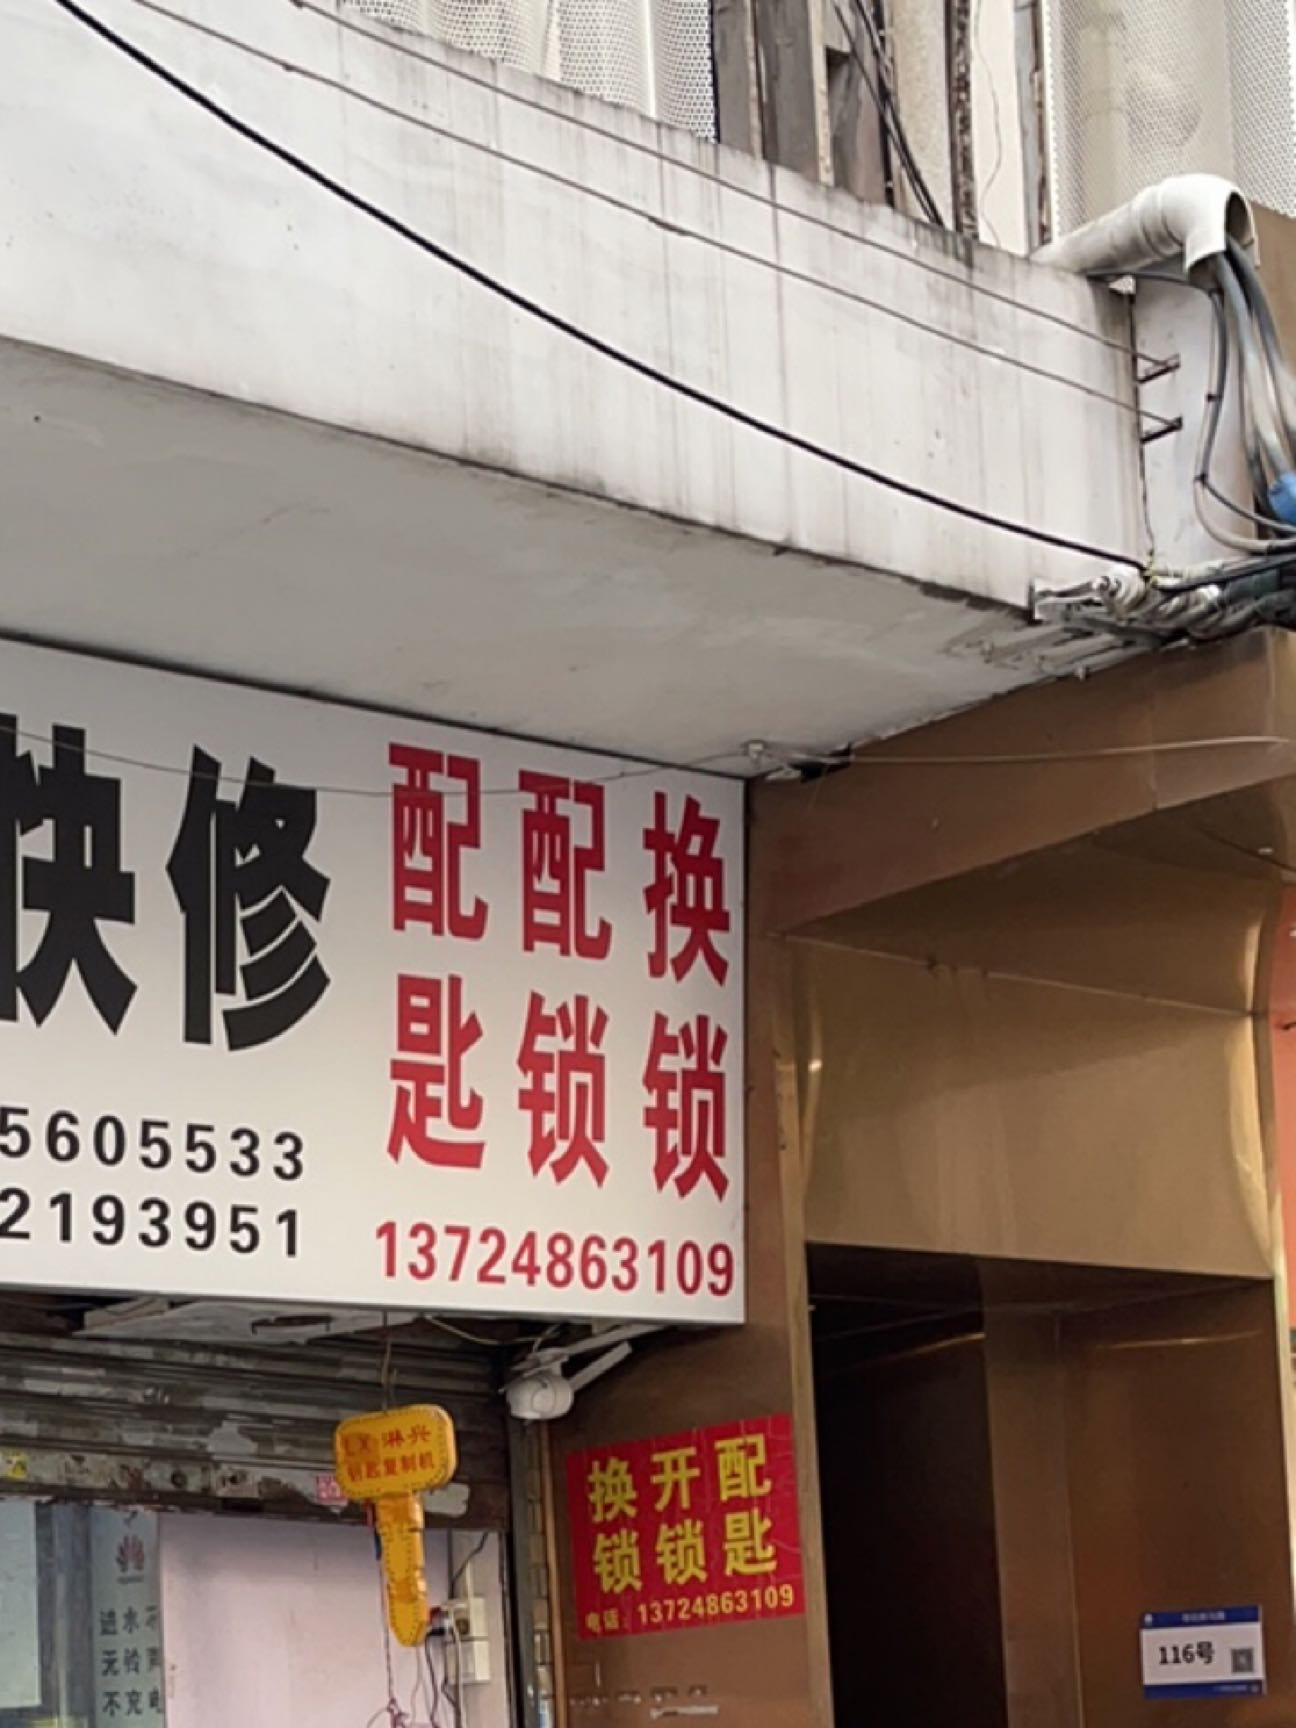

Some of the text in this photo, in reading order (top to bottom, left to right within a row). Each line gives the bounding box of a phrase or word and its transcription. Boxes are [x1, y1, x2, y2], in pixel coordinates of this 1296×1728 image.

[386, 742, 489, 1169] 配匙
[516, 768, 612, 1189] 配锁
[641, 790, 731, 1203] 换锁
[375, 1220, 735, 1298] 13724863109
[586, 1456, 643, 1595] 换锁
[649, 1446, 708, 1586] 开锁
[713, 1432, 778, 1578] 配匙
[637, 1583, 794, 1626] 13724863109
[1159, 1641, 1215, 1665] 116号
